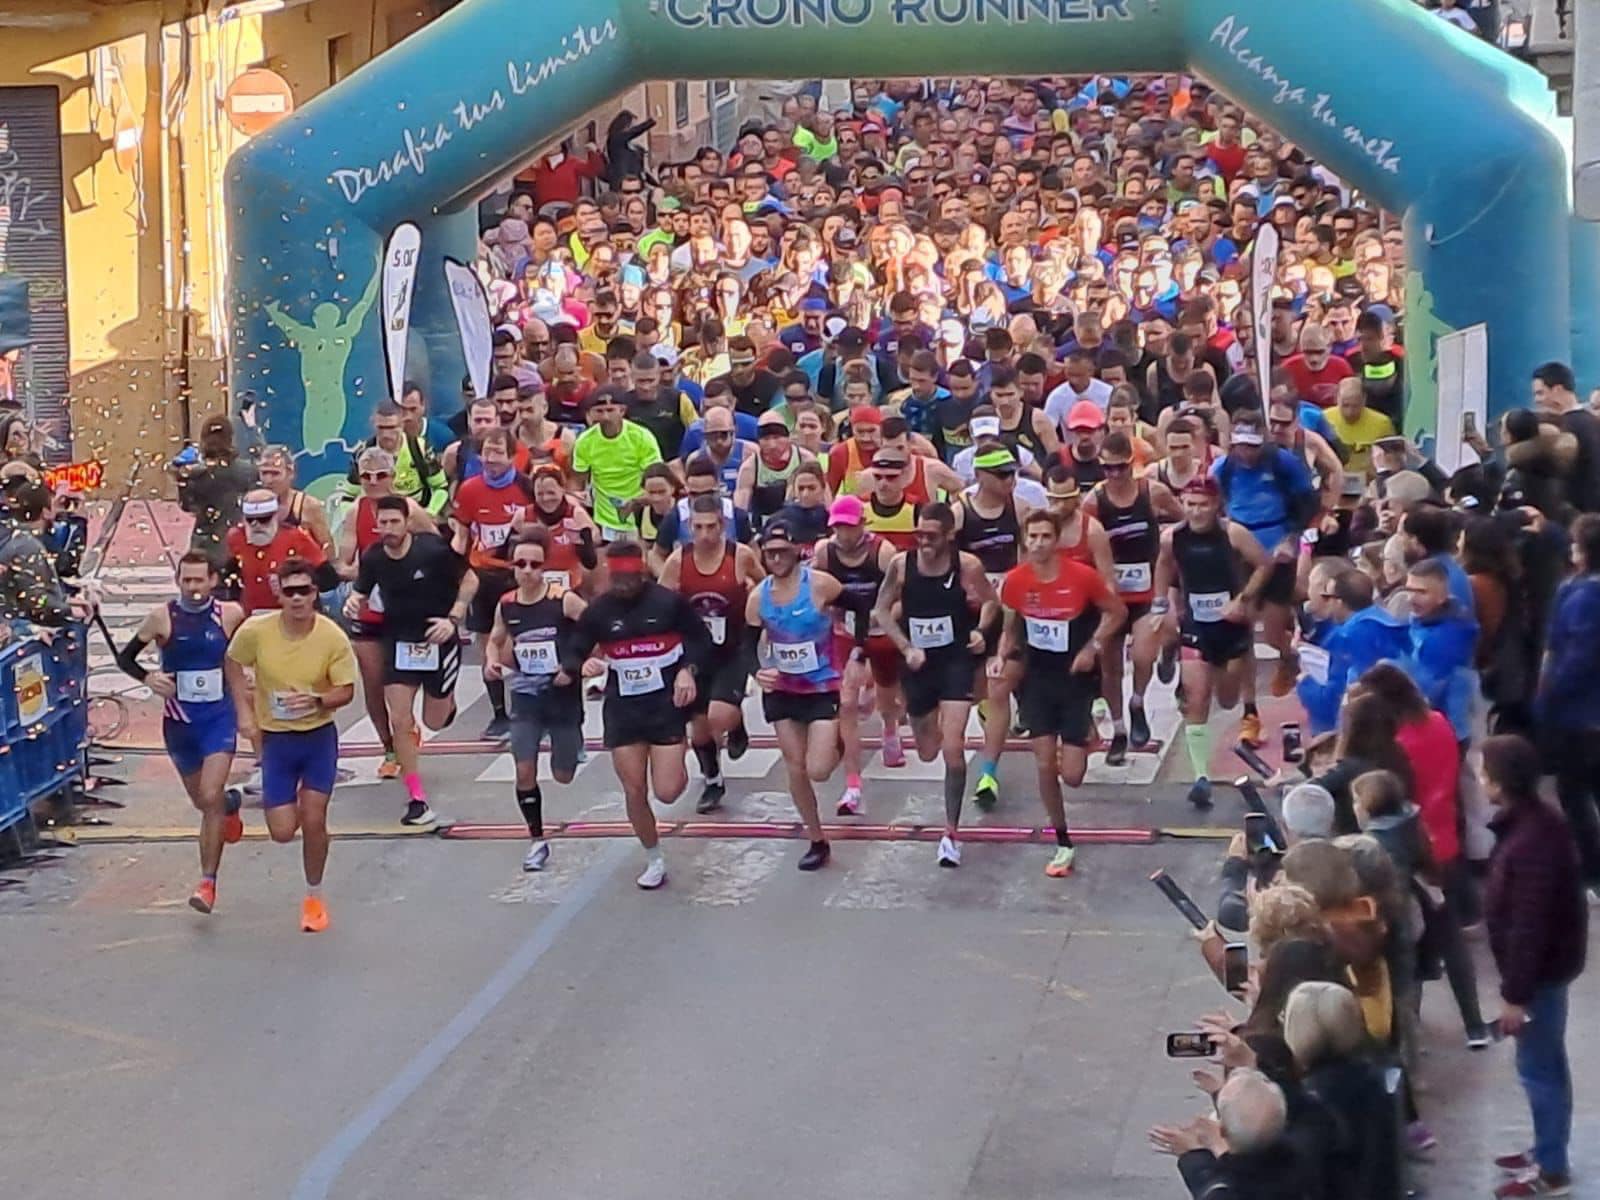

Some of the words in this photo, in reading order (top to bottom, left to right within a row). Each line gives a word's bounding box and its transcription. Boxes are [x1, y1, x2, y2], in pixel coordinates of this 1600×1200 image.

[664, 0, 873, 28] CRONO
[889, 0, 1136, 26] RUNNER
[1209, 15, 1307, 104] Alcanza
[1311, 93, 1337, 127] tu
[1342, 124, 1401, 174] meta
[331, 120, 452, 204] Desafía
[453, 98, 506, 131] tus
[507, 18, 618, 95] límites
[914, 622, 945, 635] 714
[195, 675, 207, 688] 6
